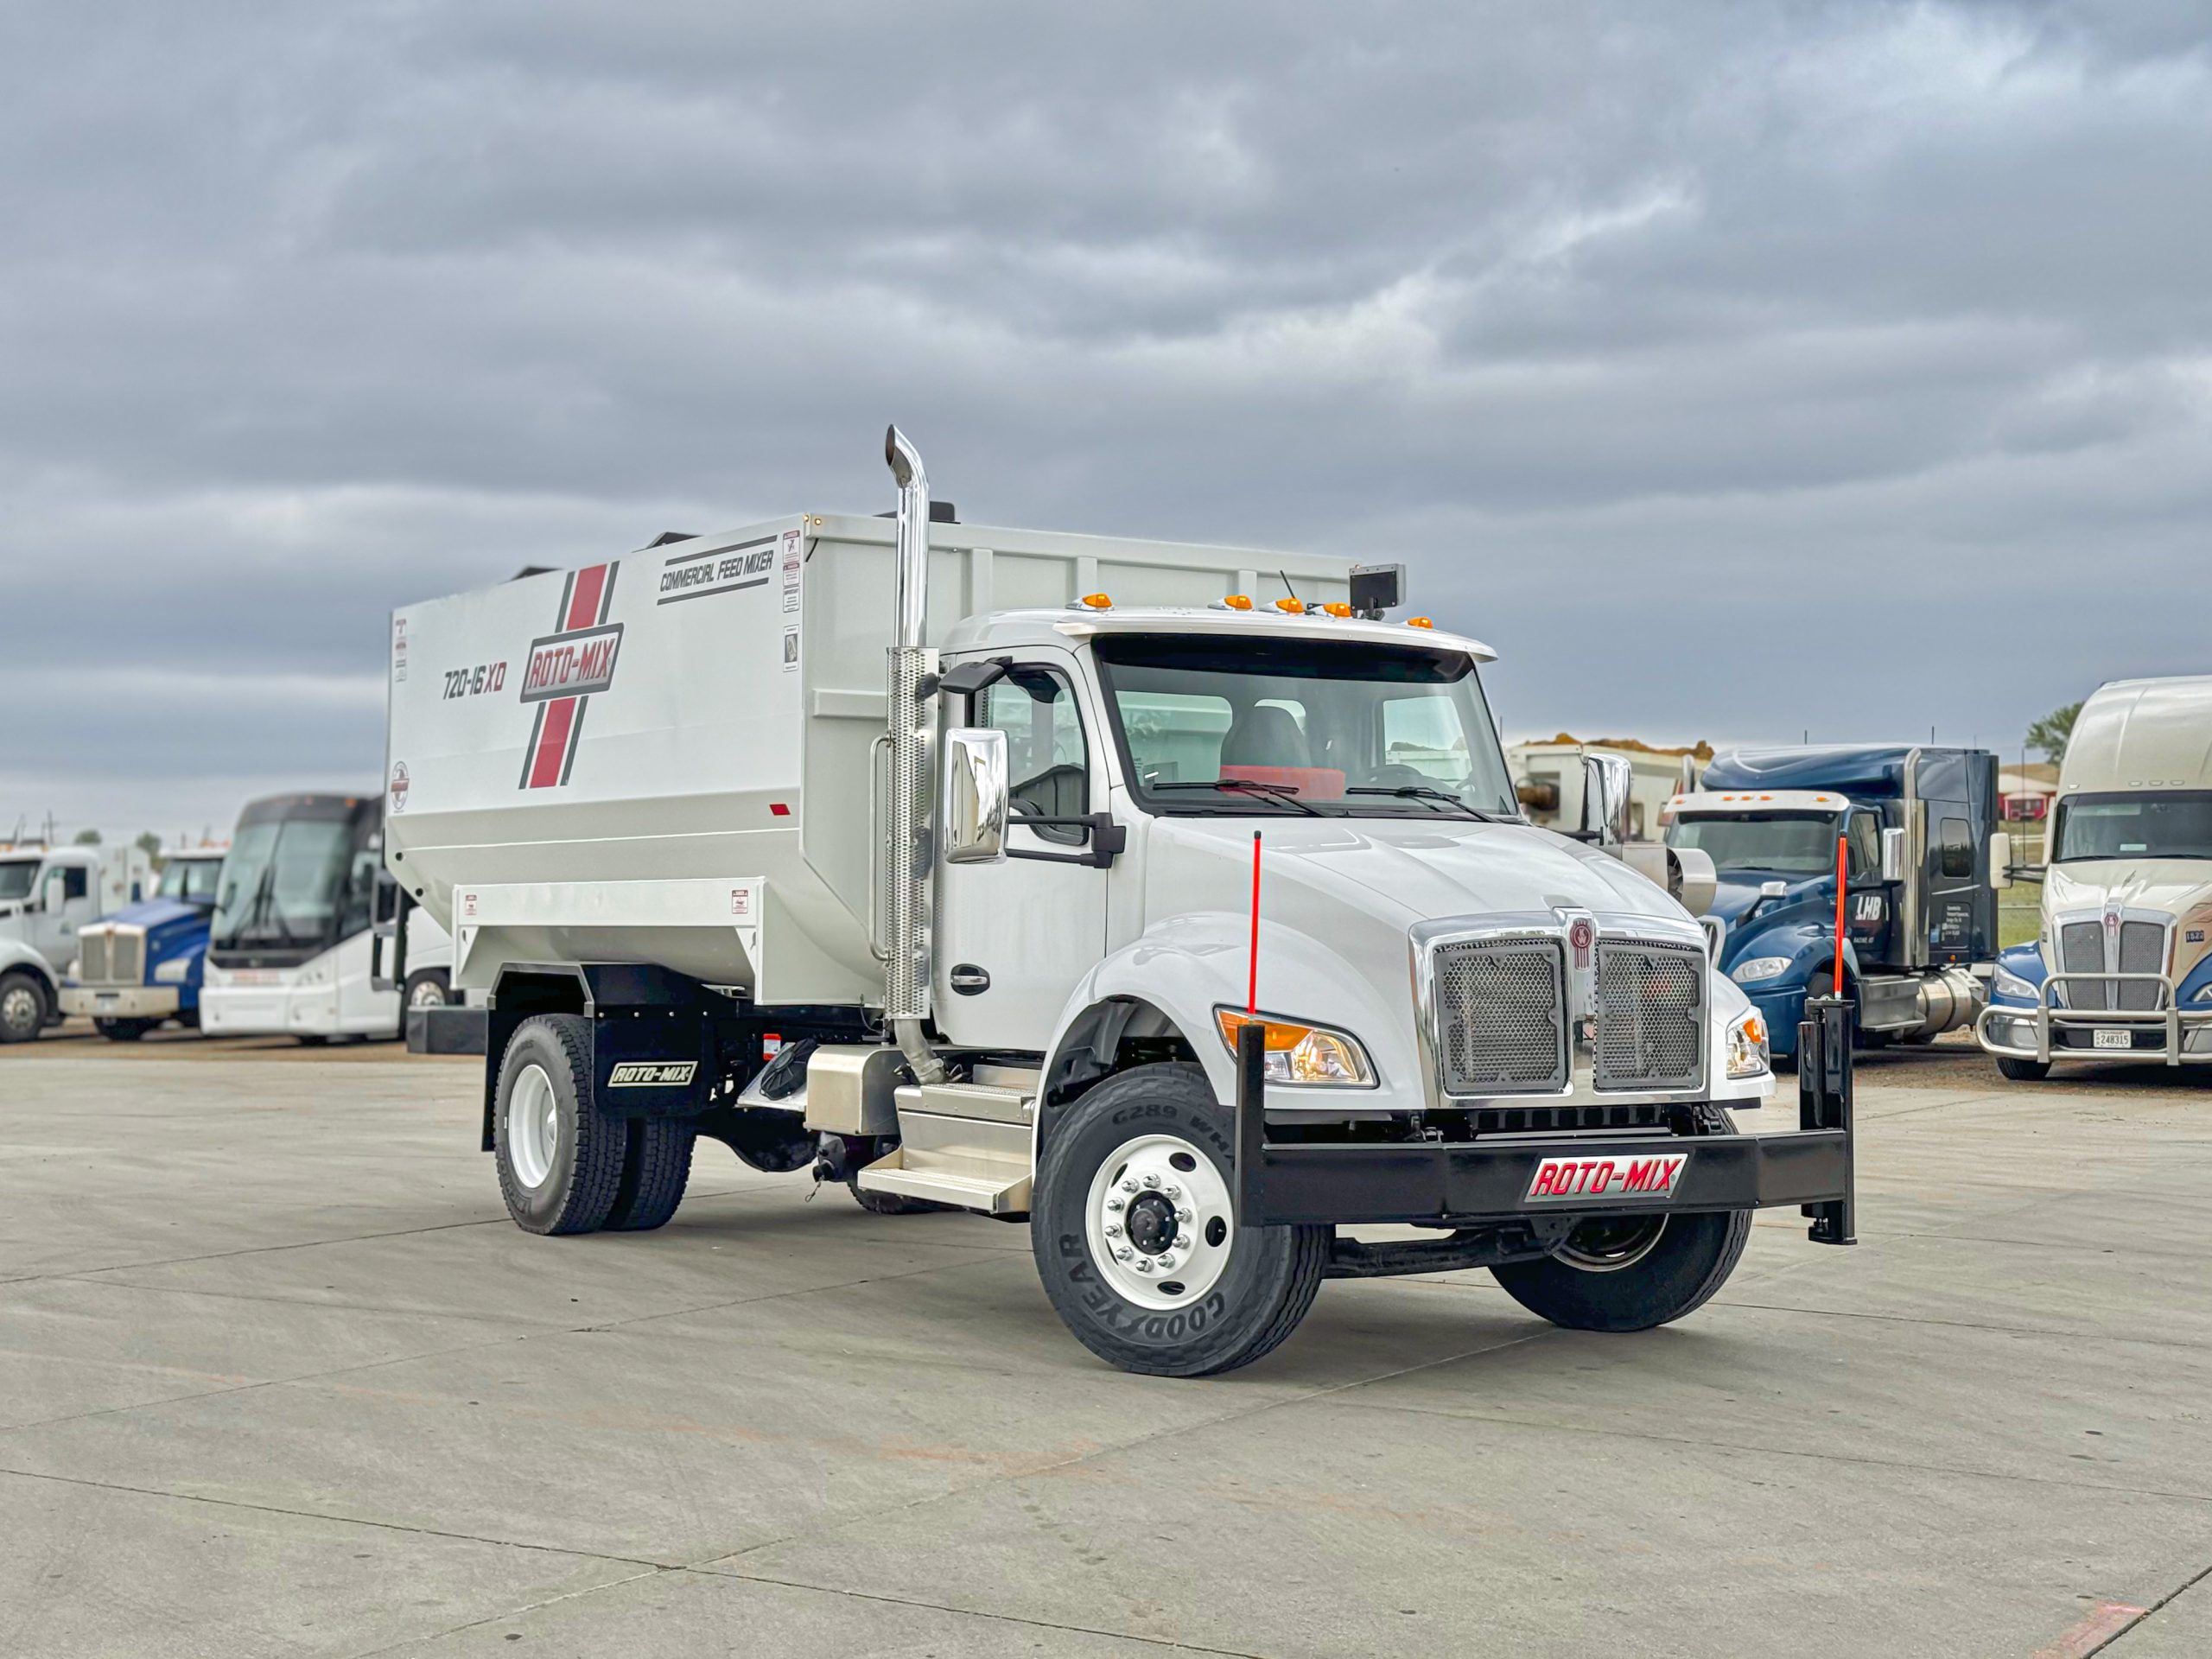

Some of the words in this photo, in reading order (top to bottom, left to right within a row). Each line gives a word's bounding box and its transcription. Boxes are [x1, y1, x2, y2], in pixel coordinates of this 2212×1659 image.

[660, 563, 715, 592] COMMERCIAL
[717, 556, 744, 580] FEED
[743, 550, 774, 575] MIXER
[528, 638, 615, 690] ROTO-MIX
[1855, 896, 1882, 921] LHB
[2101, 1035, 2129, 1045] 248315
[613, 1065, 691, 1082] ROTO-MIX
[1112, 1104, 1178, 1124] G289
[1530, 1159, 1682, 1197] ROTO-MIX
[1058, 1234, 1225, 1338] GOODYEAR
